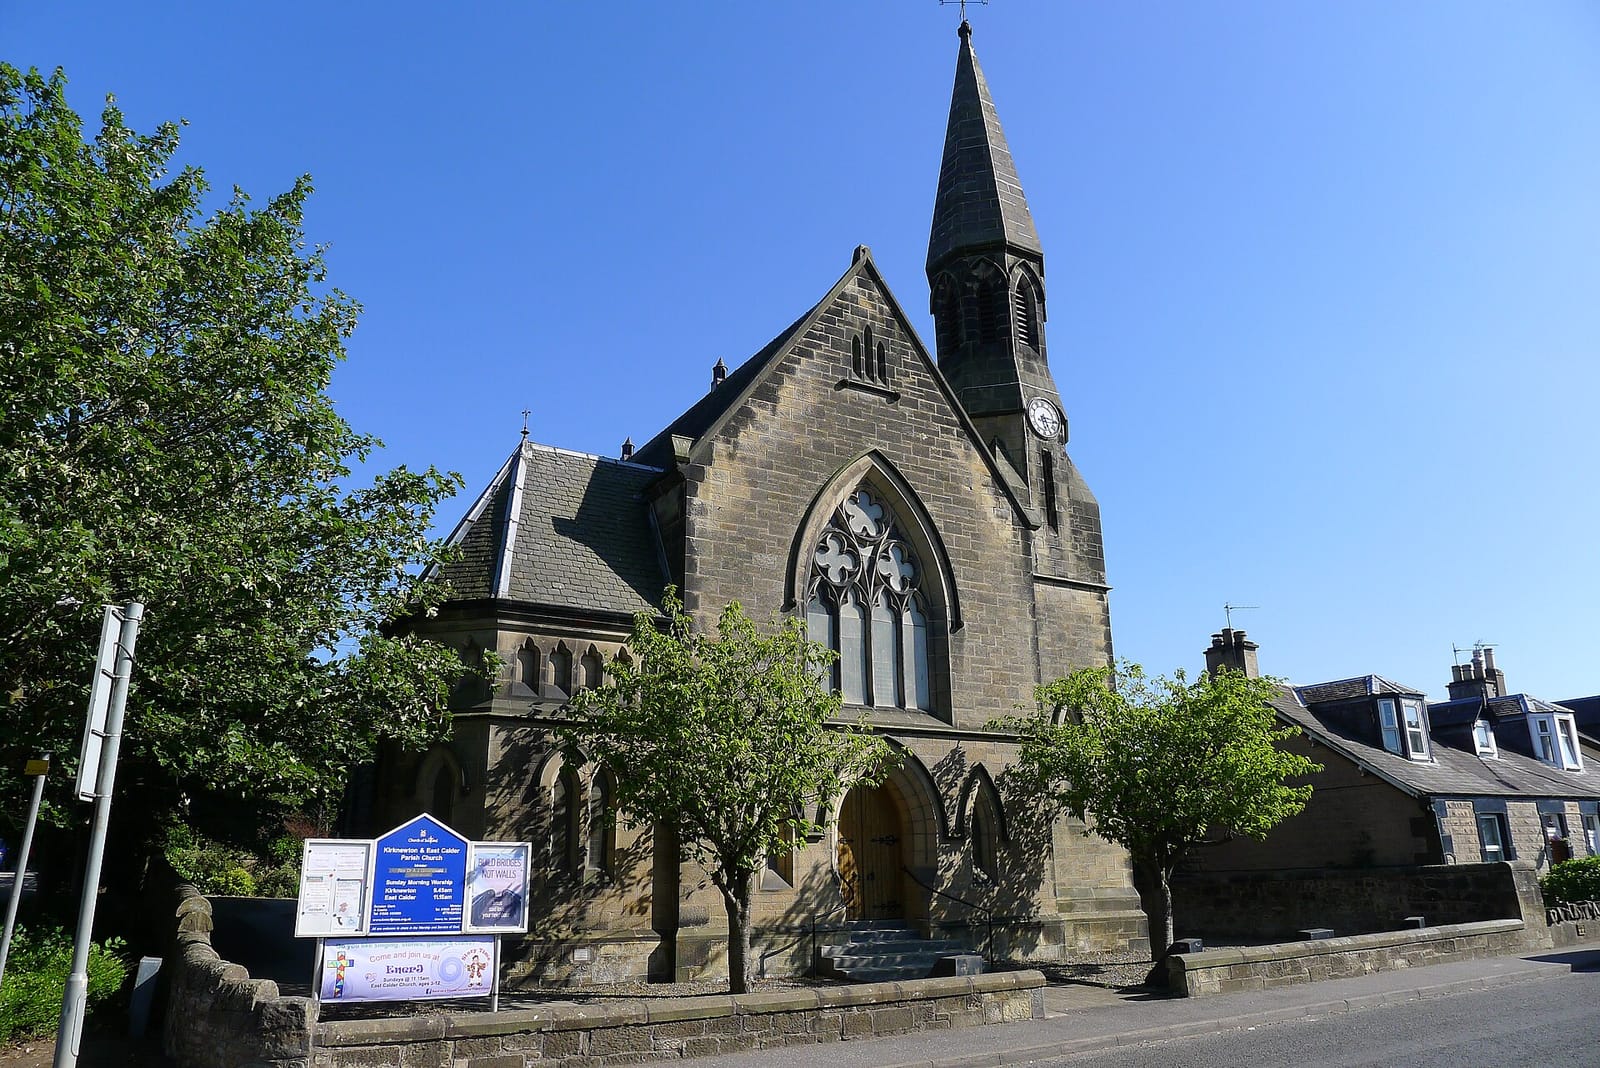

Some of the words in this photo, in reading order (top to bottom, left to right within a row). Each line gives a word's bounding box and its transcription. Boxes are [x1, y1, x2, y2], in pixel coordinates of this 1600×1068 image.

[478, 858, 496, 866] BUILD
[497, 858, 522, 866] BRIDGES
[482, 870, 494, 878] NOT
[496, 870, 516, 878] WALLS
[370, 954, 391, 963] Come
[408, 951, 421, 959] join
[461, 949, 476, 961] Story
[479, 948, 490, 960] Time
